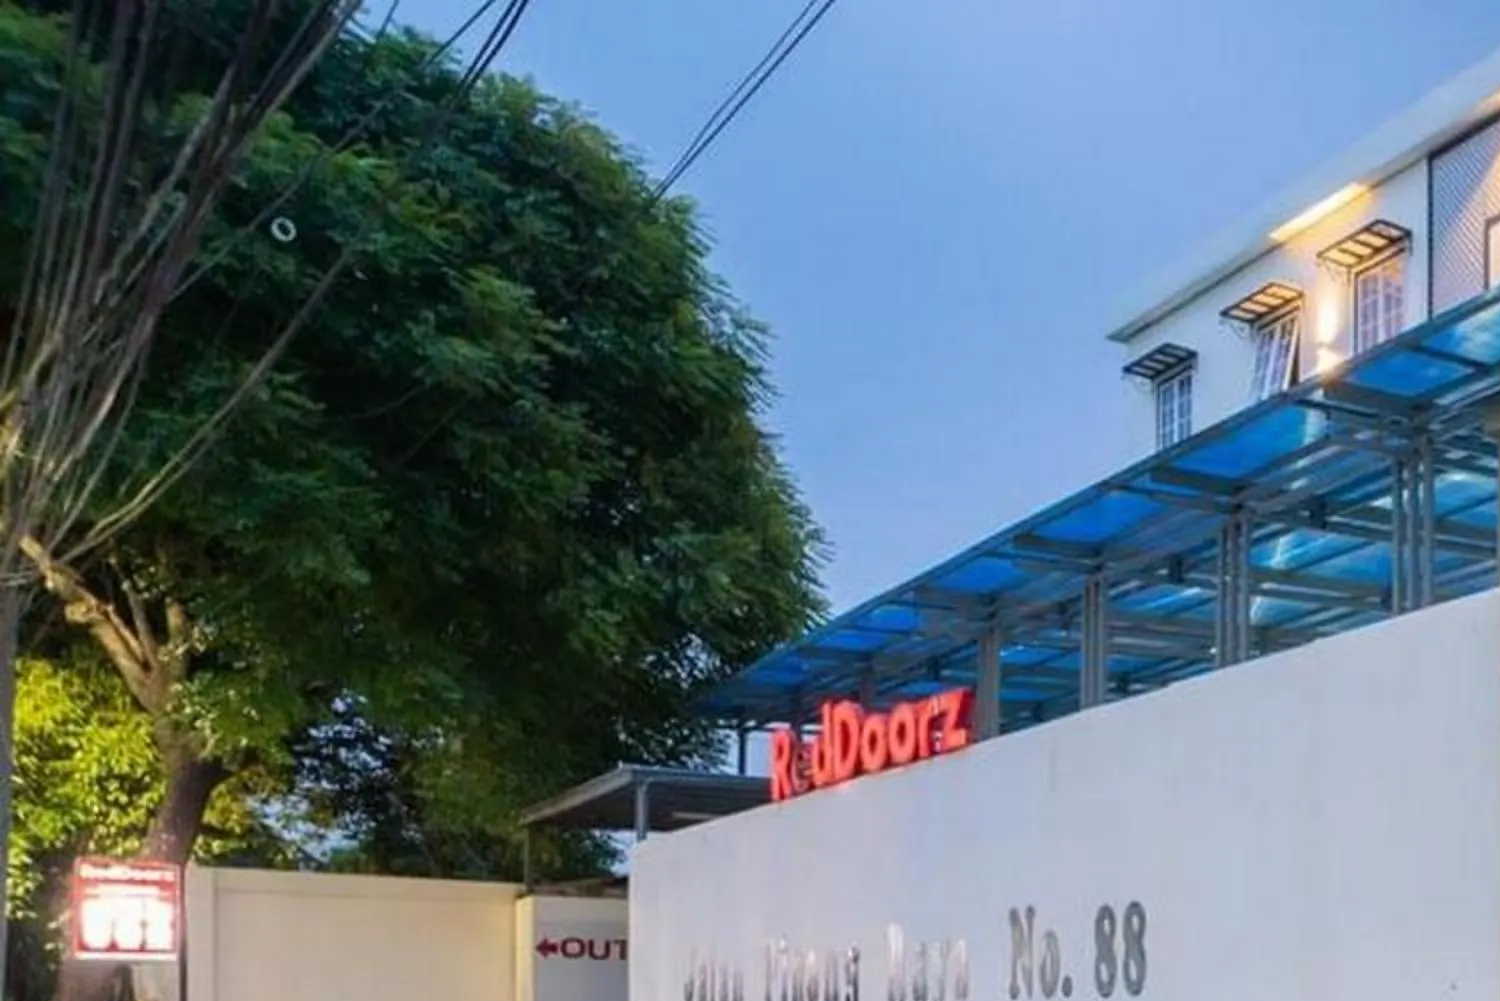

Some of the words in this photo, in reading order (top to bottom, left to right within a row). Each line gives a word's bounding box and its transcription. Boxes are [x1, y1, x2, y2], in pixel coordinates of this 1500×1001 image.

[561, 937, 628, 961] OUT
[1009, 904, 1073, 1000] No.
[1094, 901, 1147, 998] 88
